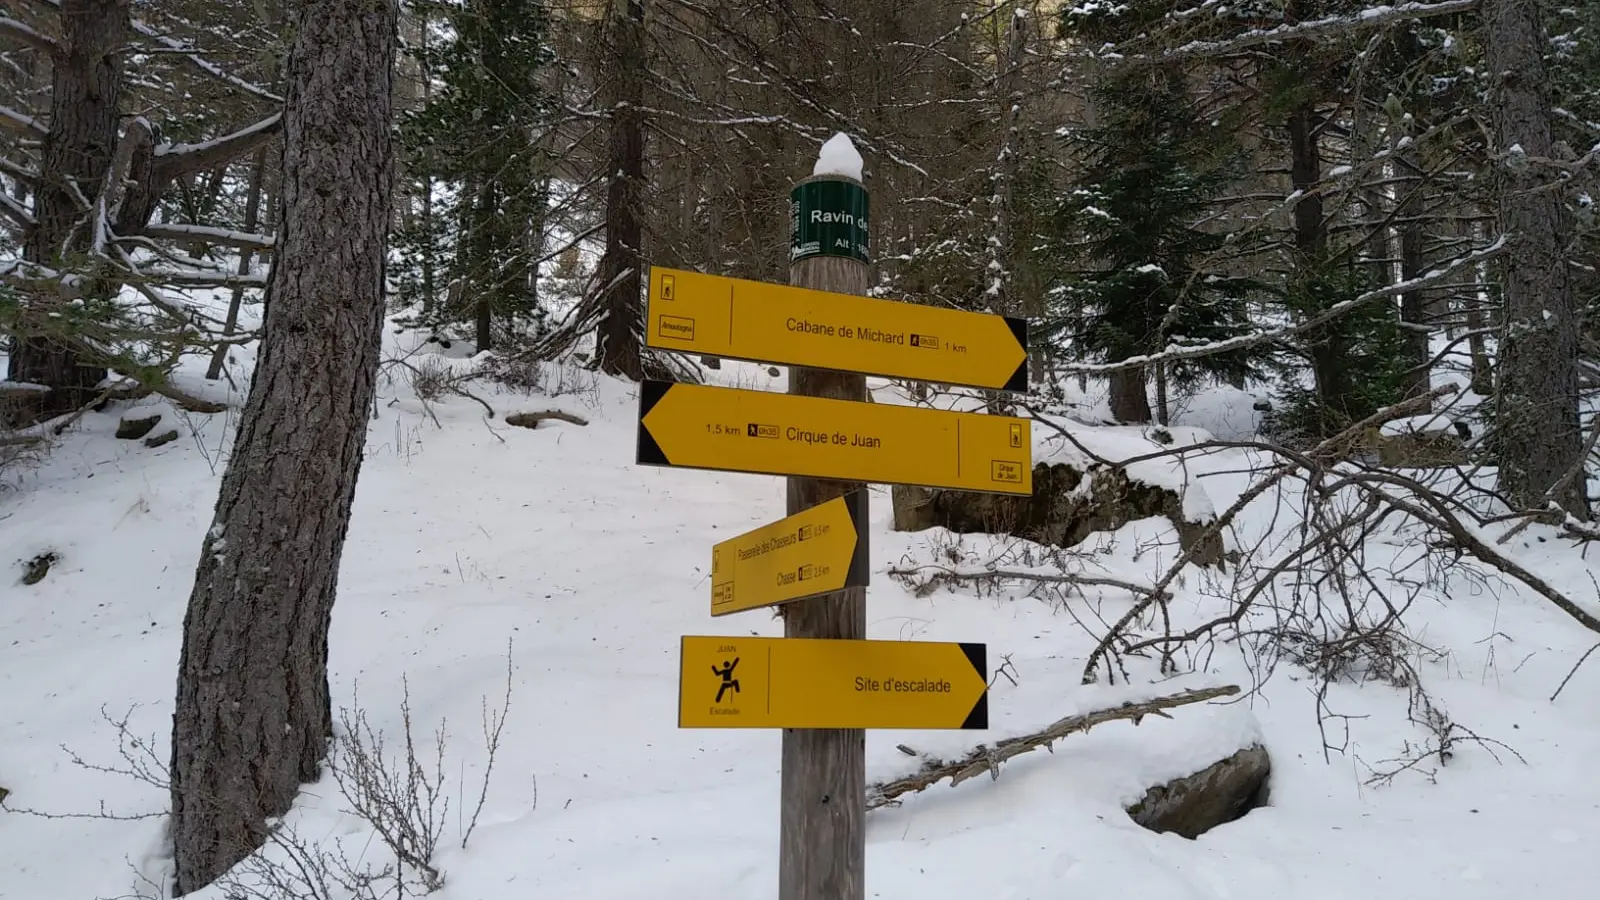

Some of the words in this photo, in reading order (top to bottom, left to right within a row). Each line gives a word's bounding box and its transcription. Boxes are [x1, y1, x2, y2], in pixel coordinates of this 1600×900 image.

[811, 209, 854, 225] Ravin
[834, 237, 850, 249] Alt
[786, 317, 834, 337] Cabane
[838, 324, 853, 339] de
[857, 327, 904, 345] Michard
[944, 343, 949, 351] 1
[953, 343, 967, 353] km
[705, 424, 722, 435] 1,5
[725, 425, 741, 436] km
[786, 427, 829, 445] Cirque
[832, 430, 847, 446] de
[851, 433, 881, 449] Juan
[770, 533, 797, 551] Chasseurs
[776, 572, 796, 586] Chasse
[716, 645, 737, 653] JUAN
[854, 677, 879, 692] Site
[883, 677, 951, 694] d'escalade
[709, 706, 740, 715] Escalade
